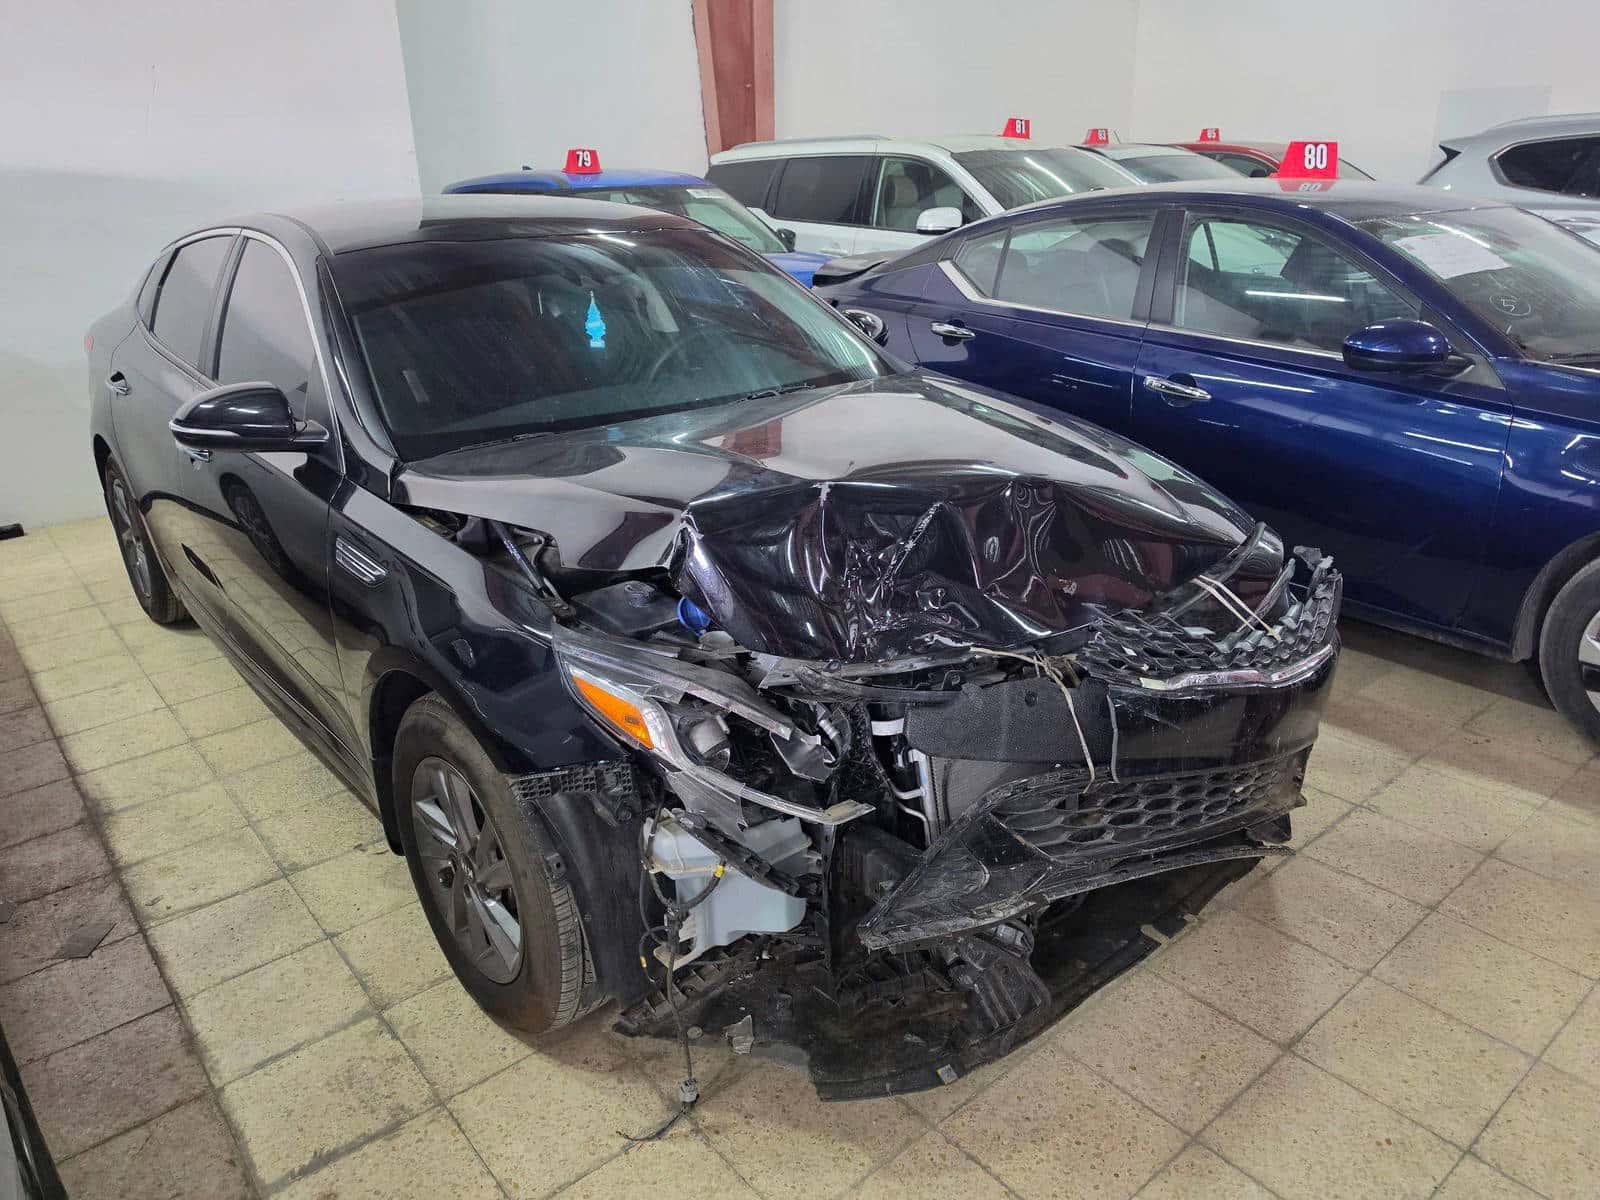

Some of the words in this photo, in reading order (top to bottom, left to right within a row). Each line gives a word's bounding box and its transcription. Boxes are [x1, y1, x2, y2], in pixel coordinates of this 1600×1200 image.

[1015, 119, 1025, 134] 81
[576, 151, 592, 168] 79
[1304, 143, 1328, 170] 80
